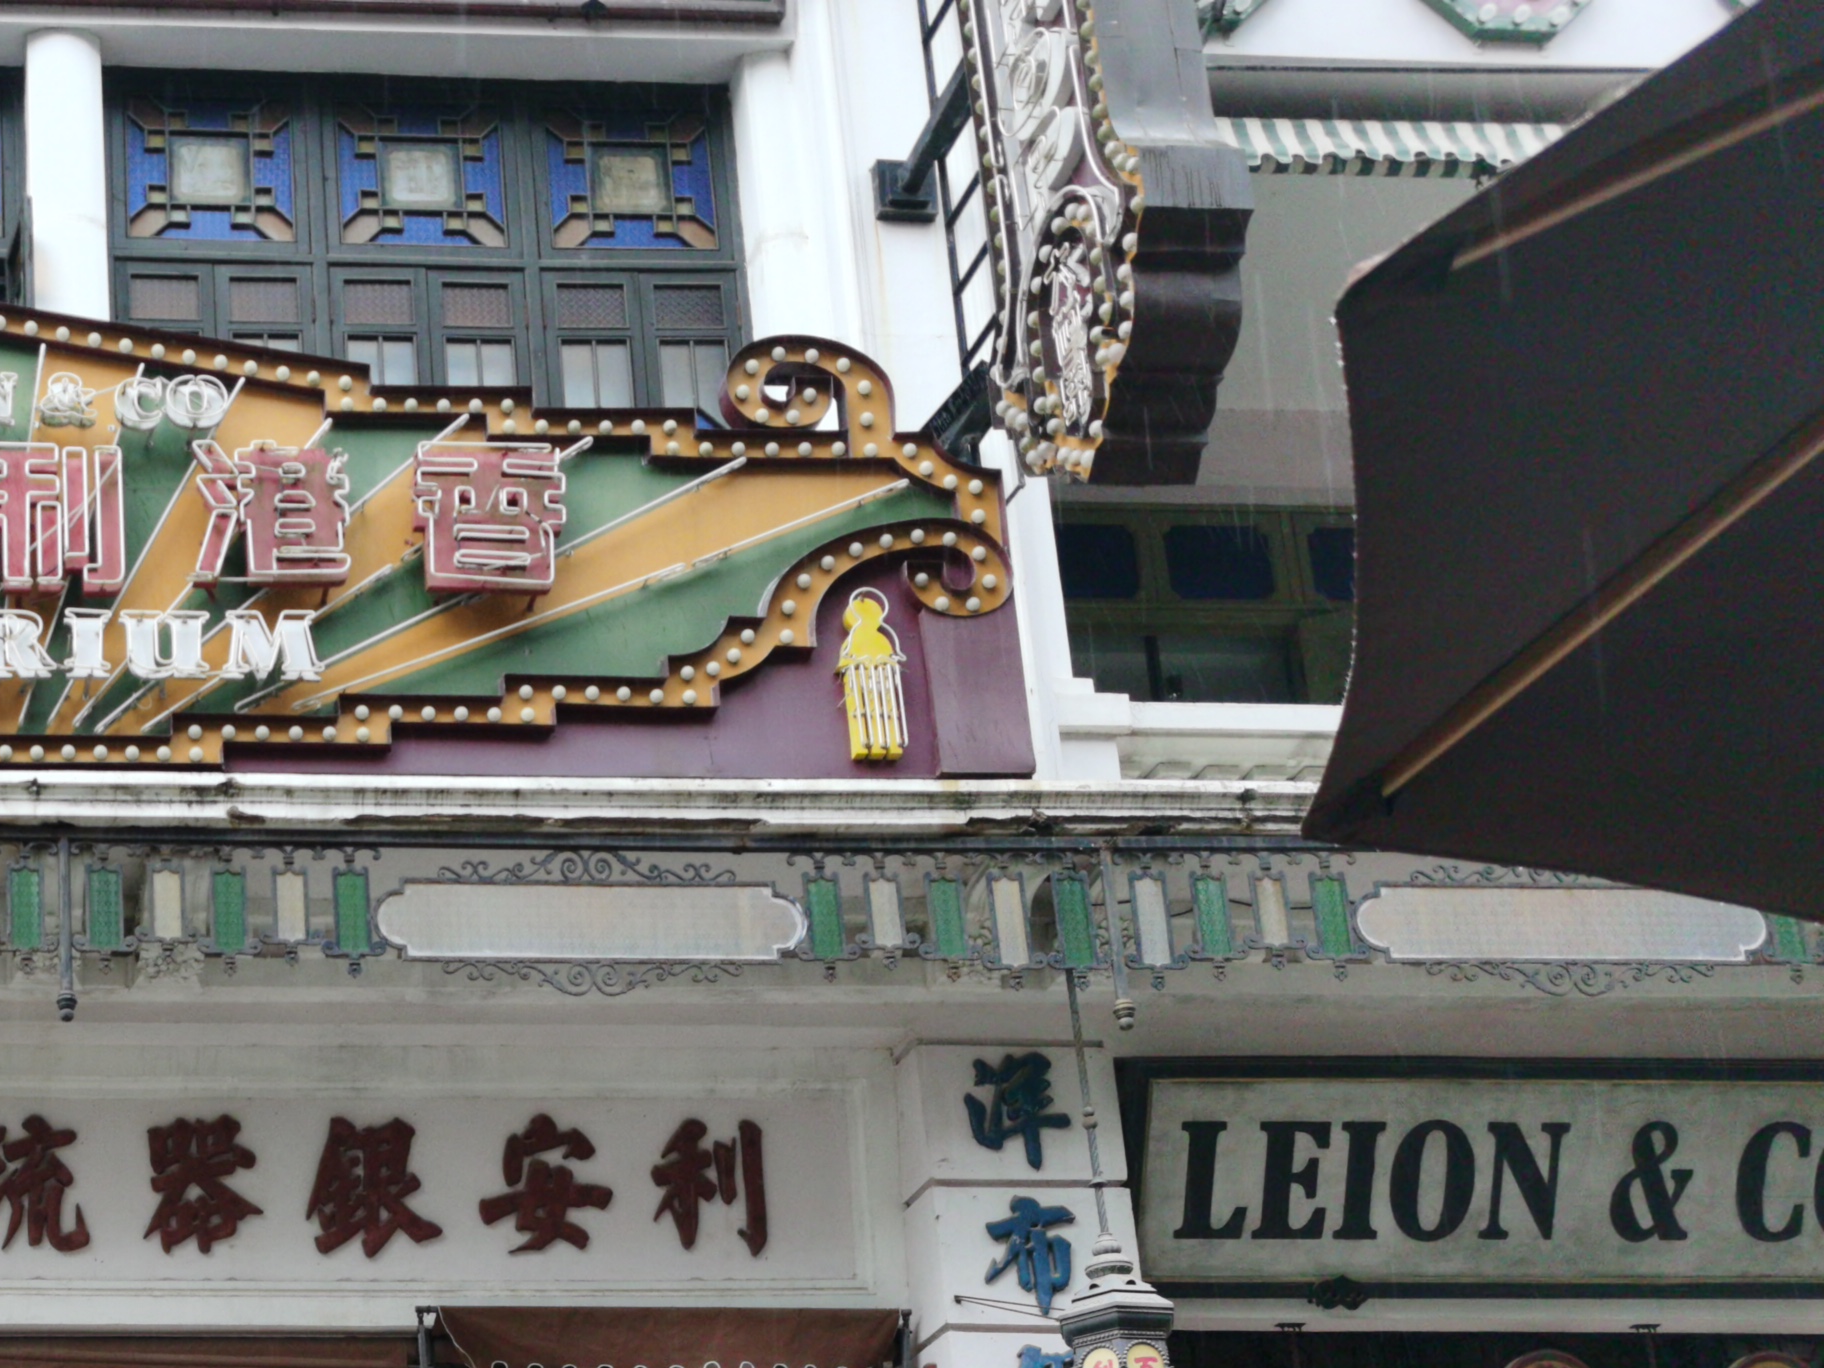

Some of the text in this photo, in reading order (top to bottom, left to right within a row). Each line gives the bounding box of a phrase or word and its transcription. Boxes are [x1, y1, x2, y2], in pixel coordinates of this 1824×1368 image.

[1172, 1119, 1824, 1242] LEION & C
